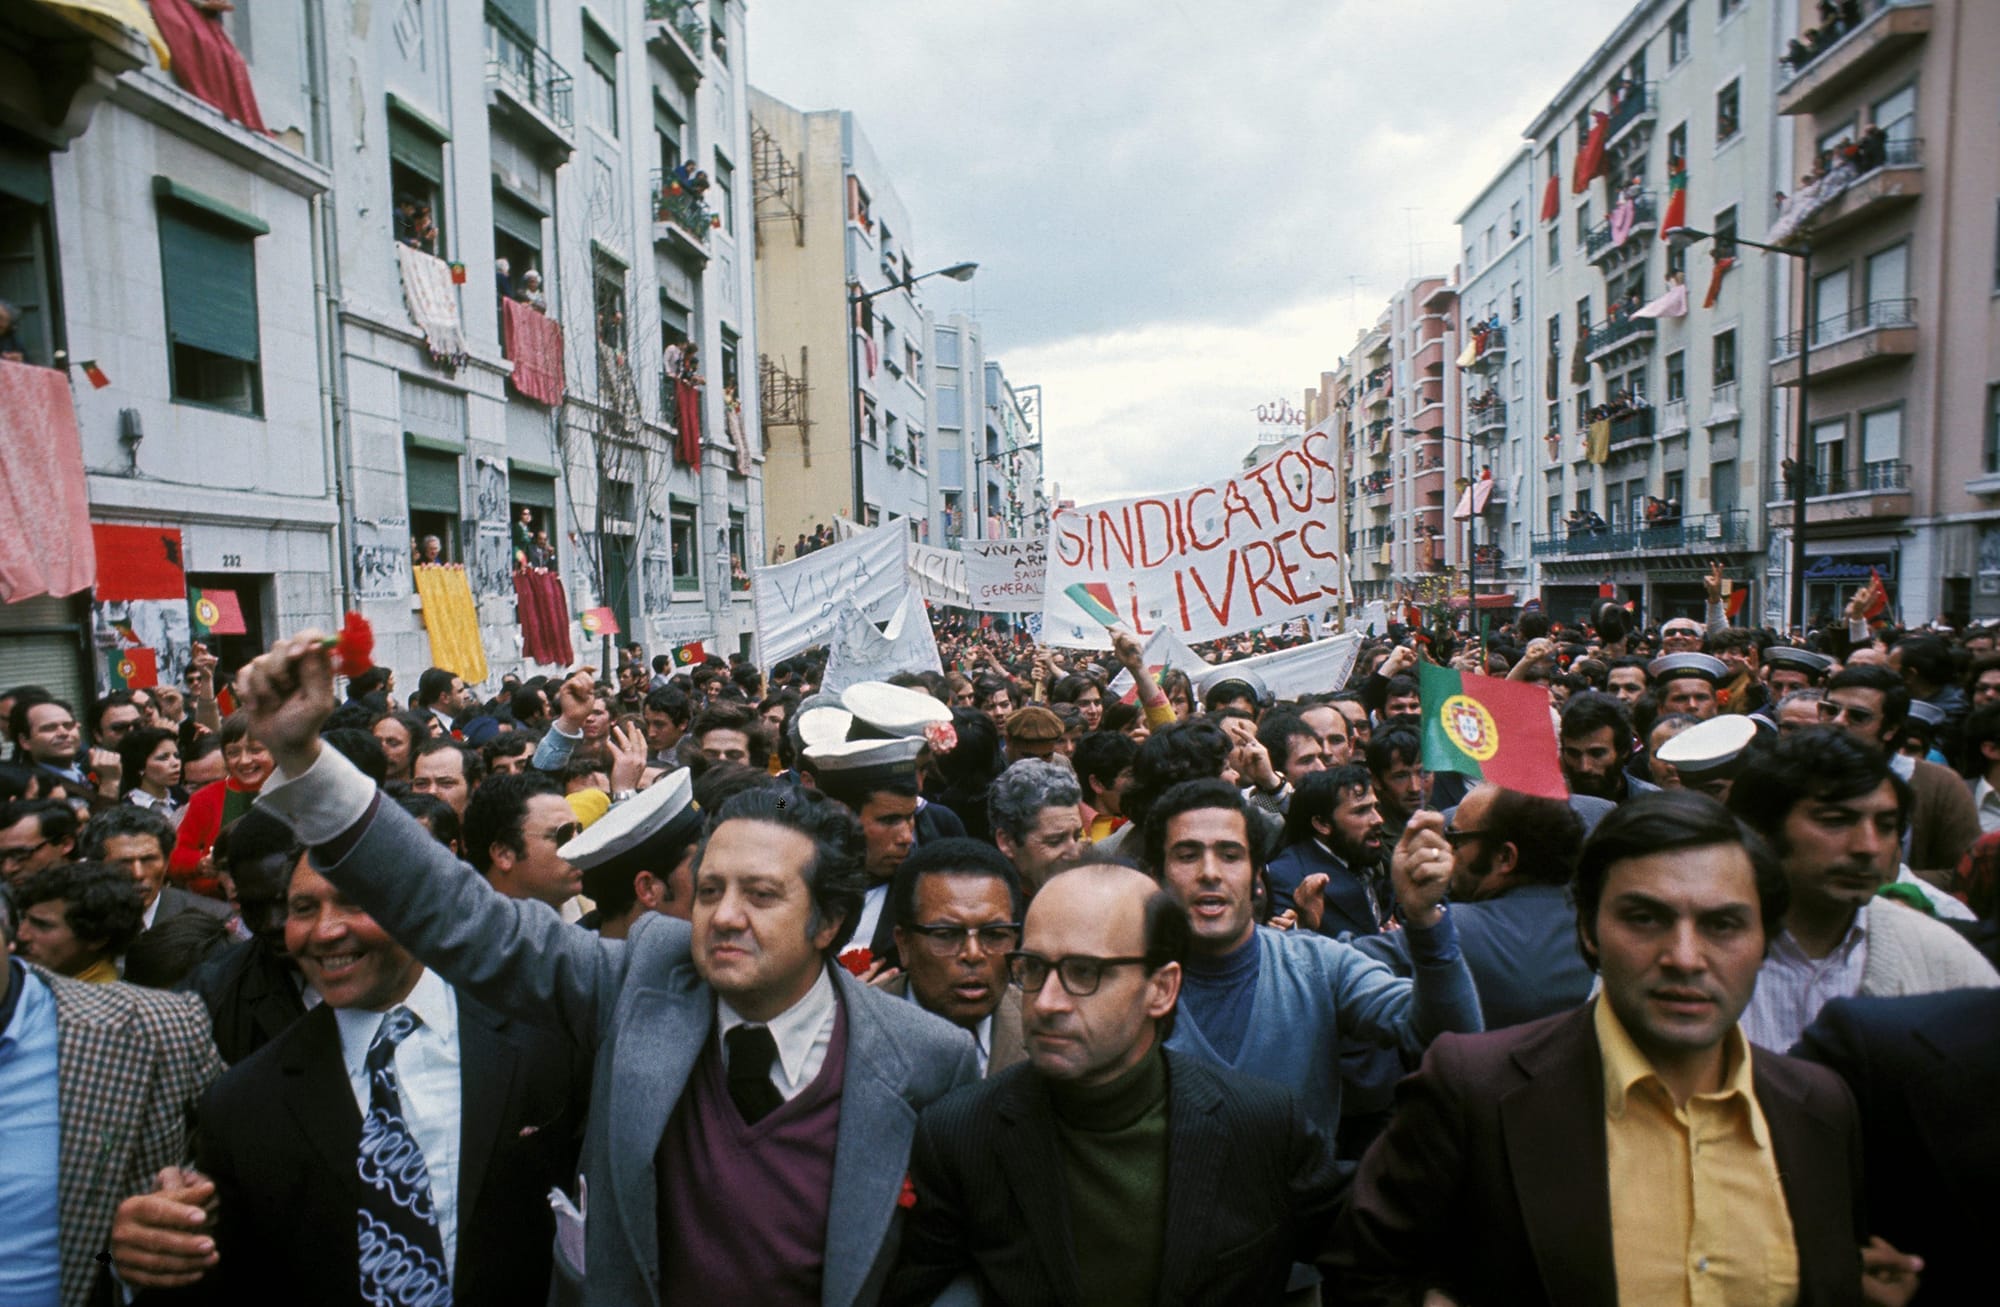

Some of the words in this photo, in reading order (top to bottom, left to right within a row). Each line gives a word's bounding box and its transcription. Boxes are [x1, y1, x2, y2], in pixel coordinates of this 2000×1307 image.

[1052, 432, 1337, 570] SINDICATOS
[974, 544, 1022, 558] VIVA
[1025, 540, 1045, 554] AS
[1128, 520, 1338, 635] LIVRES
[774, 556, 872, 614] VIVA
[980, 582, 1045, 598] GENERAL
